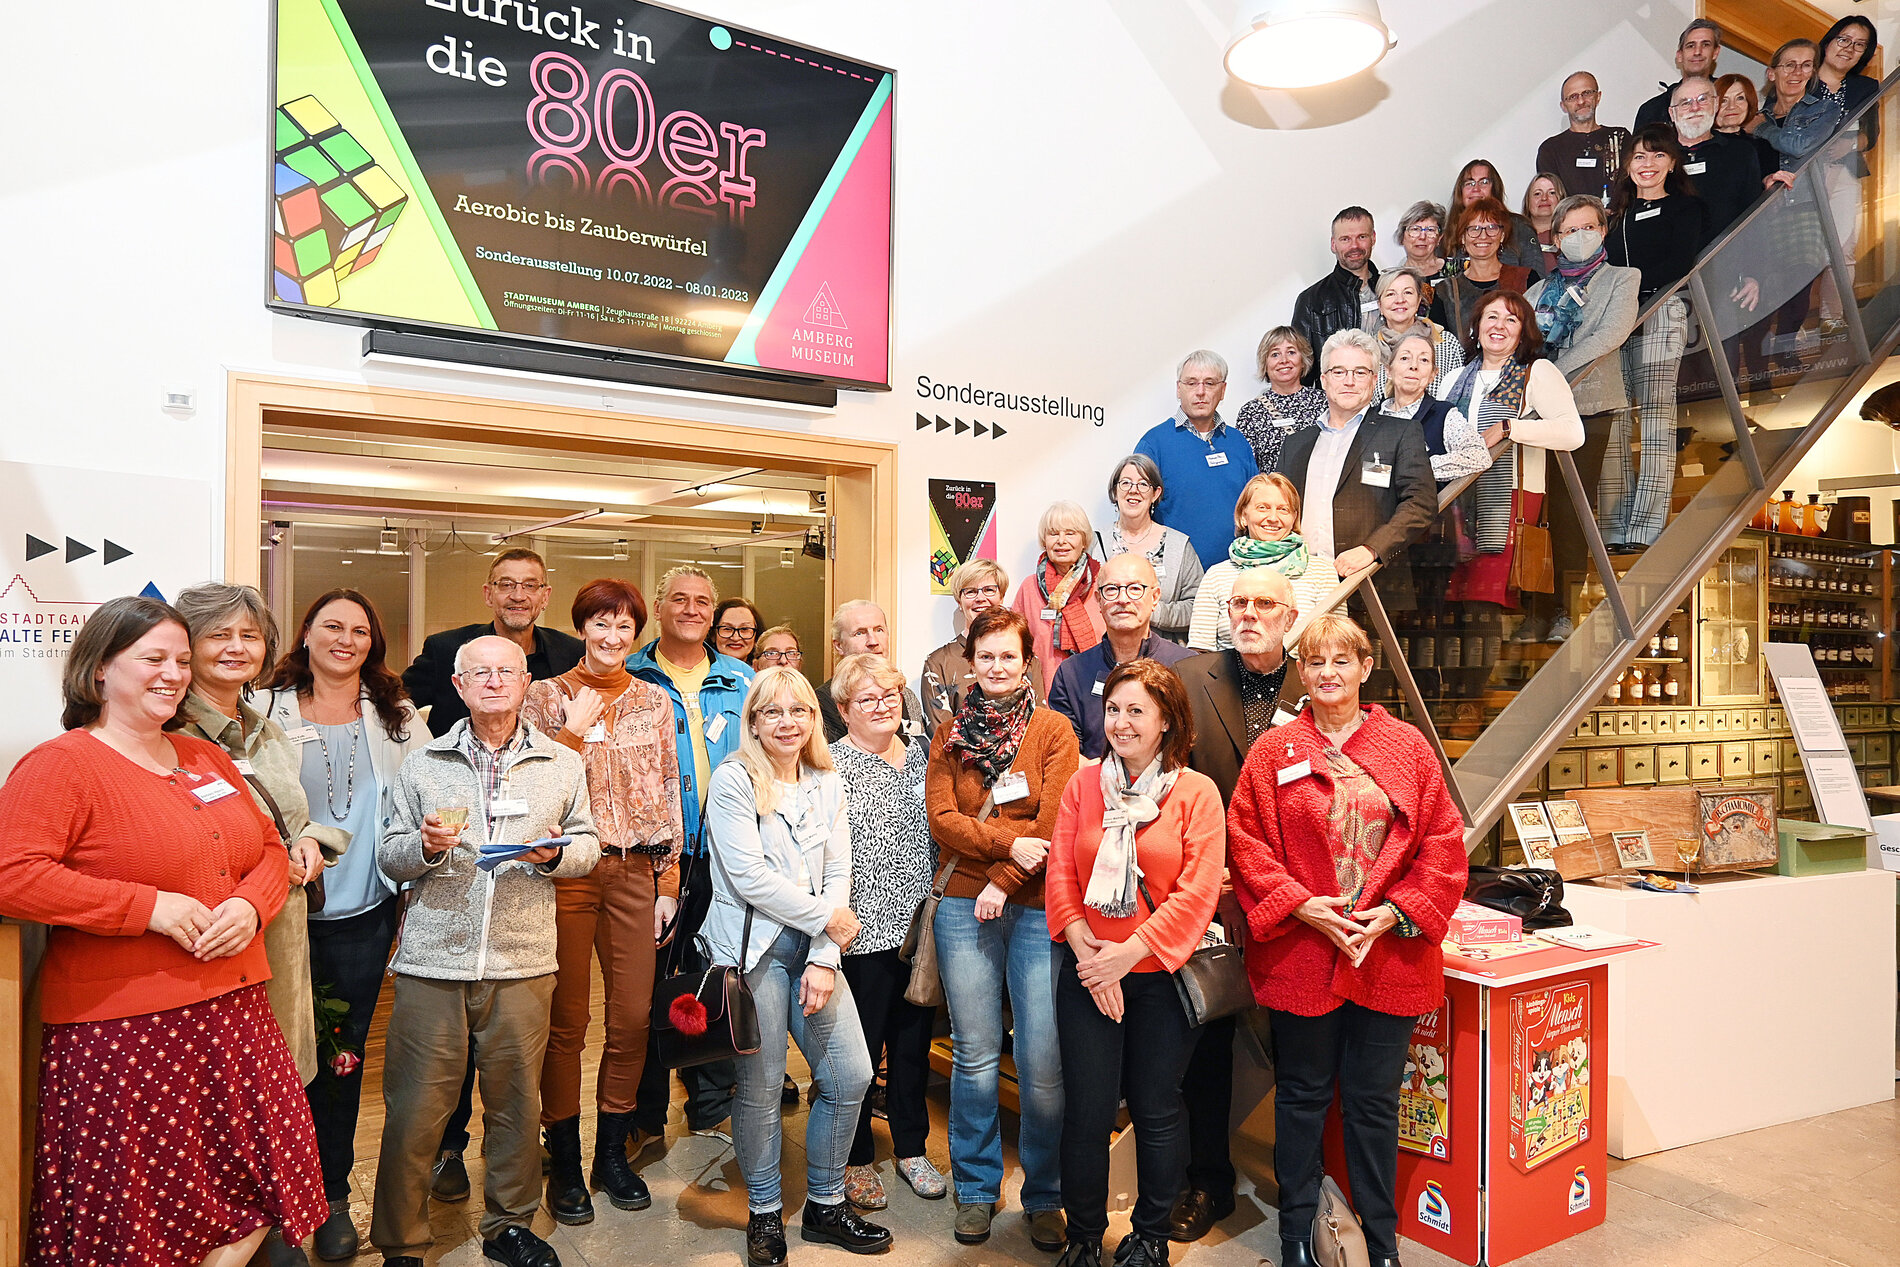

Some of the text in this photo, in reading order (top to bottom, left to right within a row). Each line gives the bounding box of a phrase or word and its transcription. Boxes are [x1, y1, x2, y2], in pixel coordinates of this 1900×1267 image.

[425, 0, 656, 64] urück in
[425, 35, 767, 193] die 80er
[453, 194, 708, 257] Aerobic bis Zauberwürfel
[475, 246, 603, 281] Sonderausstellung
[606, 267, 673, 290] 10.07.2022
[685, 281, 749, 302] 08.01.2023
[503, 291, 565, 307] STADTMUSEUM
[566, 301, 600, 312] AMBERG
[606, 306, 659, 322] Zeughausstraße
[675, 317, 696, 327] 92224
[503, 299, 557, 314] Öffnungszeiten:
[558, 308, 574, 317] Di-Fr
[576, 311, 595, 320] 11-16
[600, 314, 609, 322] Sa
[626, 318, 645, 327] 11-17
[646, 321, 658, 329] Uhr
[663, 324, 686, 335] Montag
[686, 327, 722, 338] geschlossen
[792, 328, 853, 349] AMBERG
[791, 346, 854, 367] MUSEUM
[916, 375, 1105, 427] Sonderausstellung
[945, 484, 965, 492] Zurück
[955, 492, 984, 508] 80er
[0, 629, 42, 643] ALTE
[1563, 992, 1576, 1005] Kids
[1569, 1198, 1590, 1213] Schmidt
[1419, 1211, 1450, 1232] Schmidt
